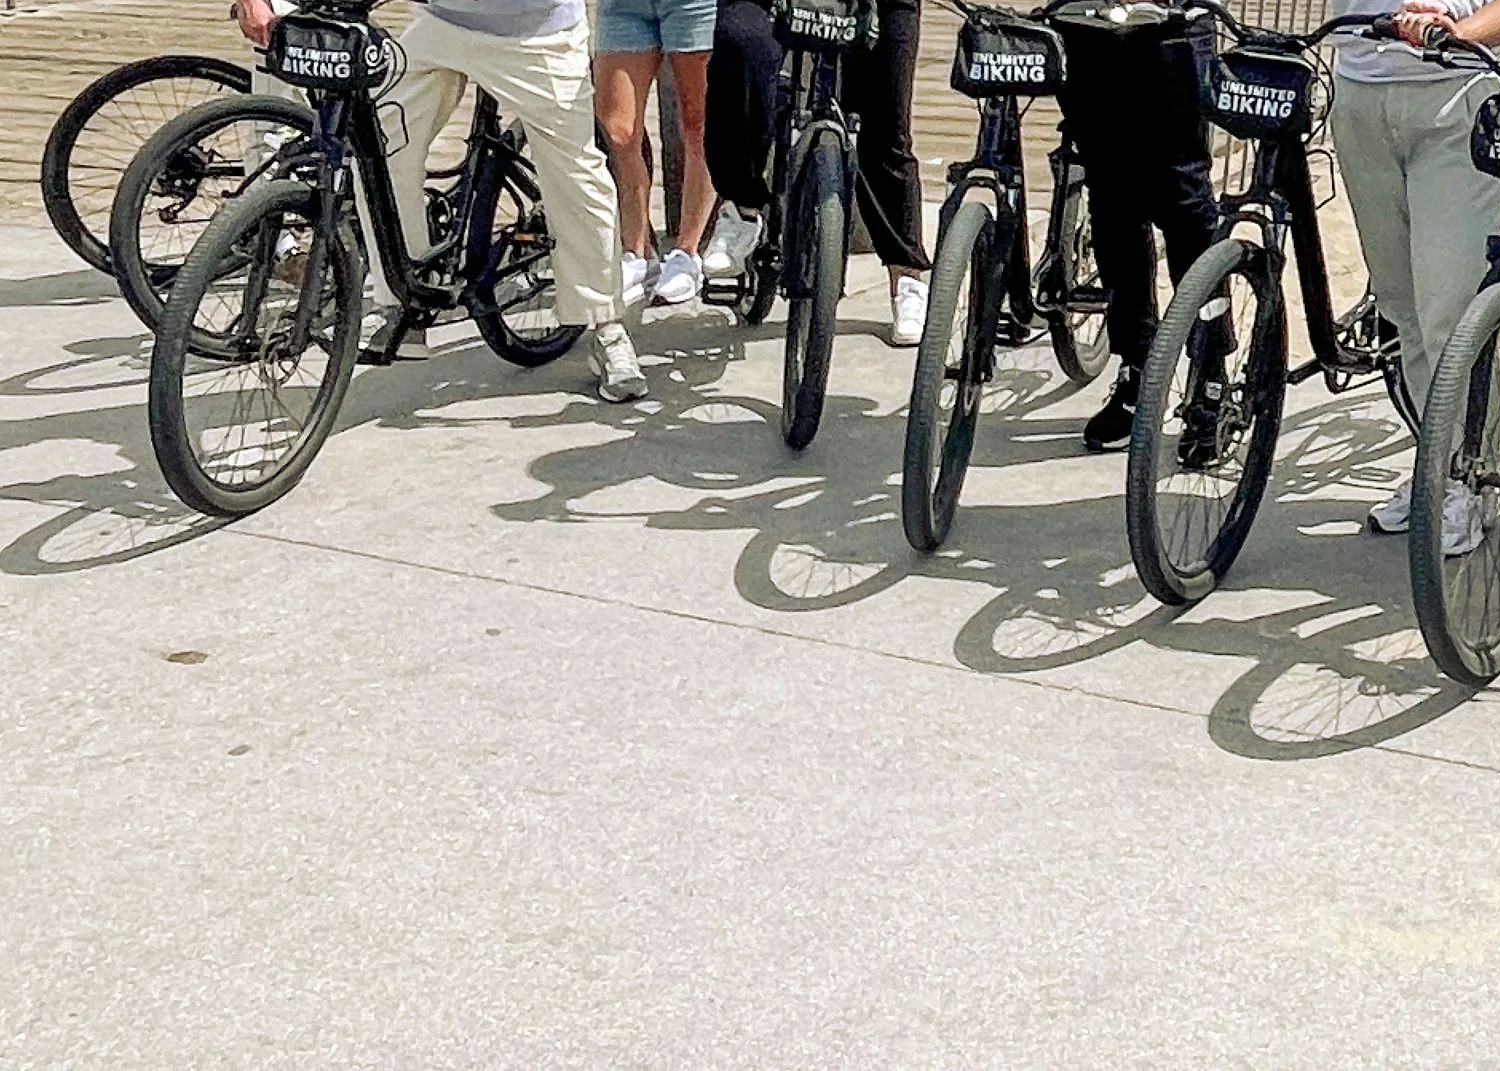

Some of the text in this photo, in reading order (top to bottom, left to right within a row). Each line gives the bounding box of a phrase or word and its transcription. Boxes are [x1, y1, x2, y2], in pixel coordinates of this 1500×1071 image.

[793, 8, 858, 27] UNLIMITED
[791, 19, 856, 42] BIKING
[972, 51, 1046, 66] UNLIMITED
[969, 63, 1046, 83] BIKING
[1221, 80, 1297, 102] UNLIMITED
[1217, 92, 1293, 118] BIKING
